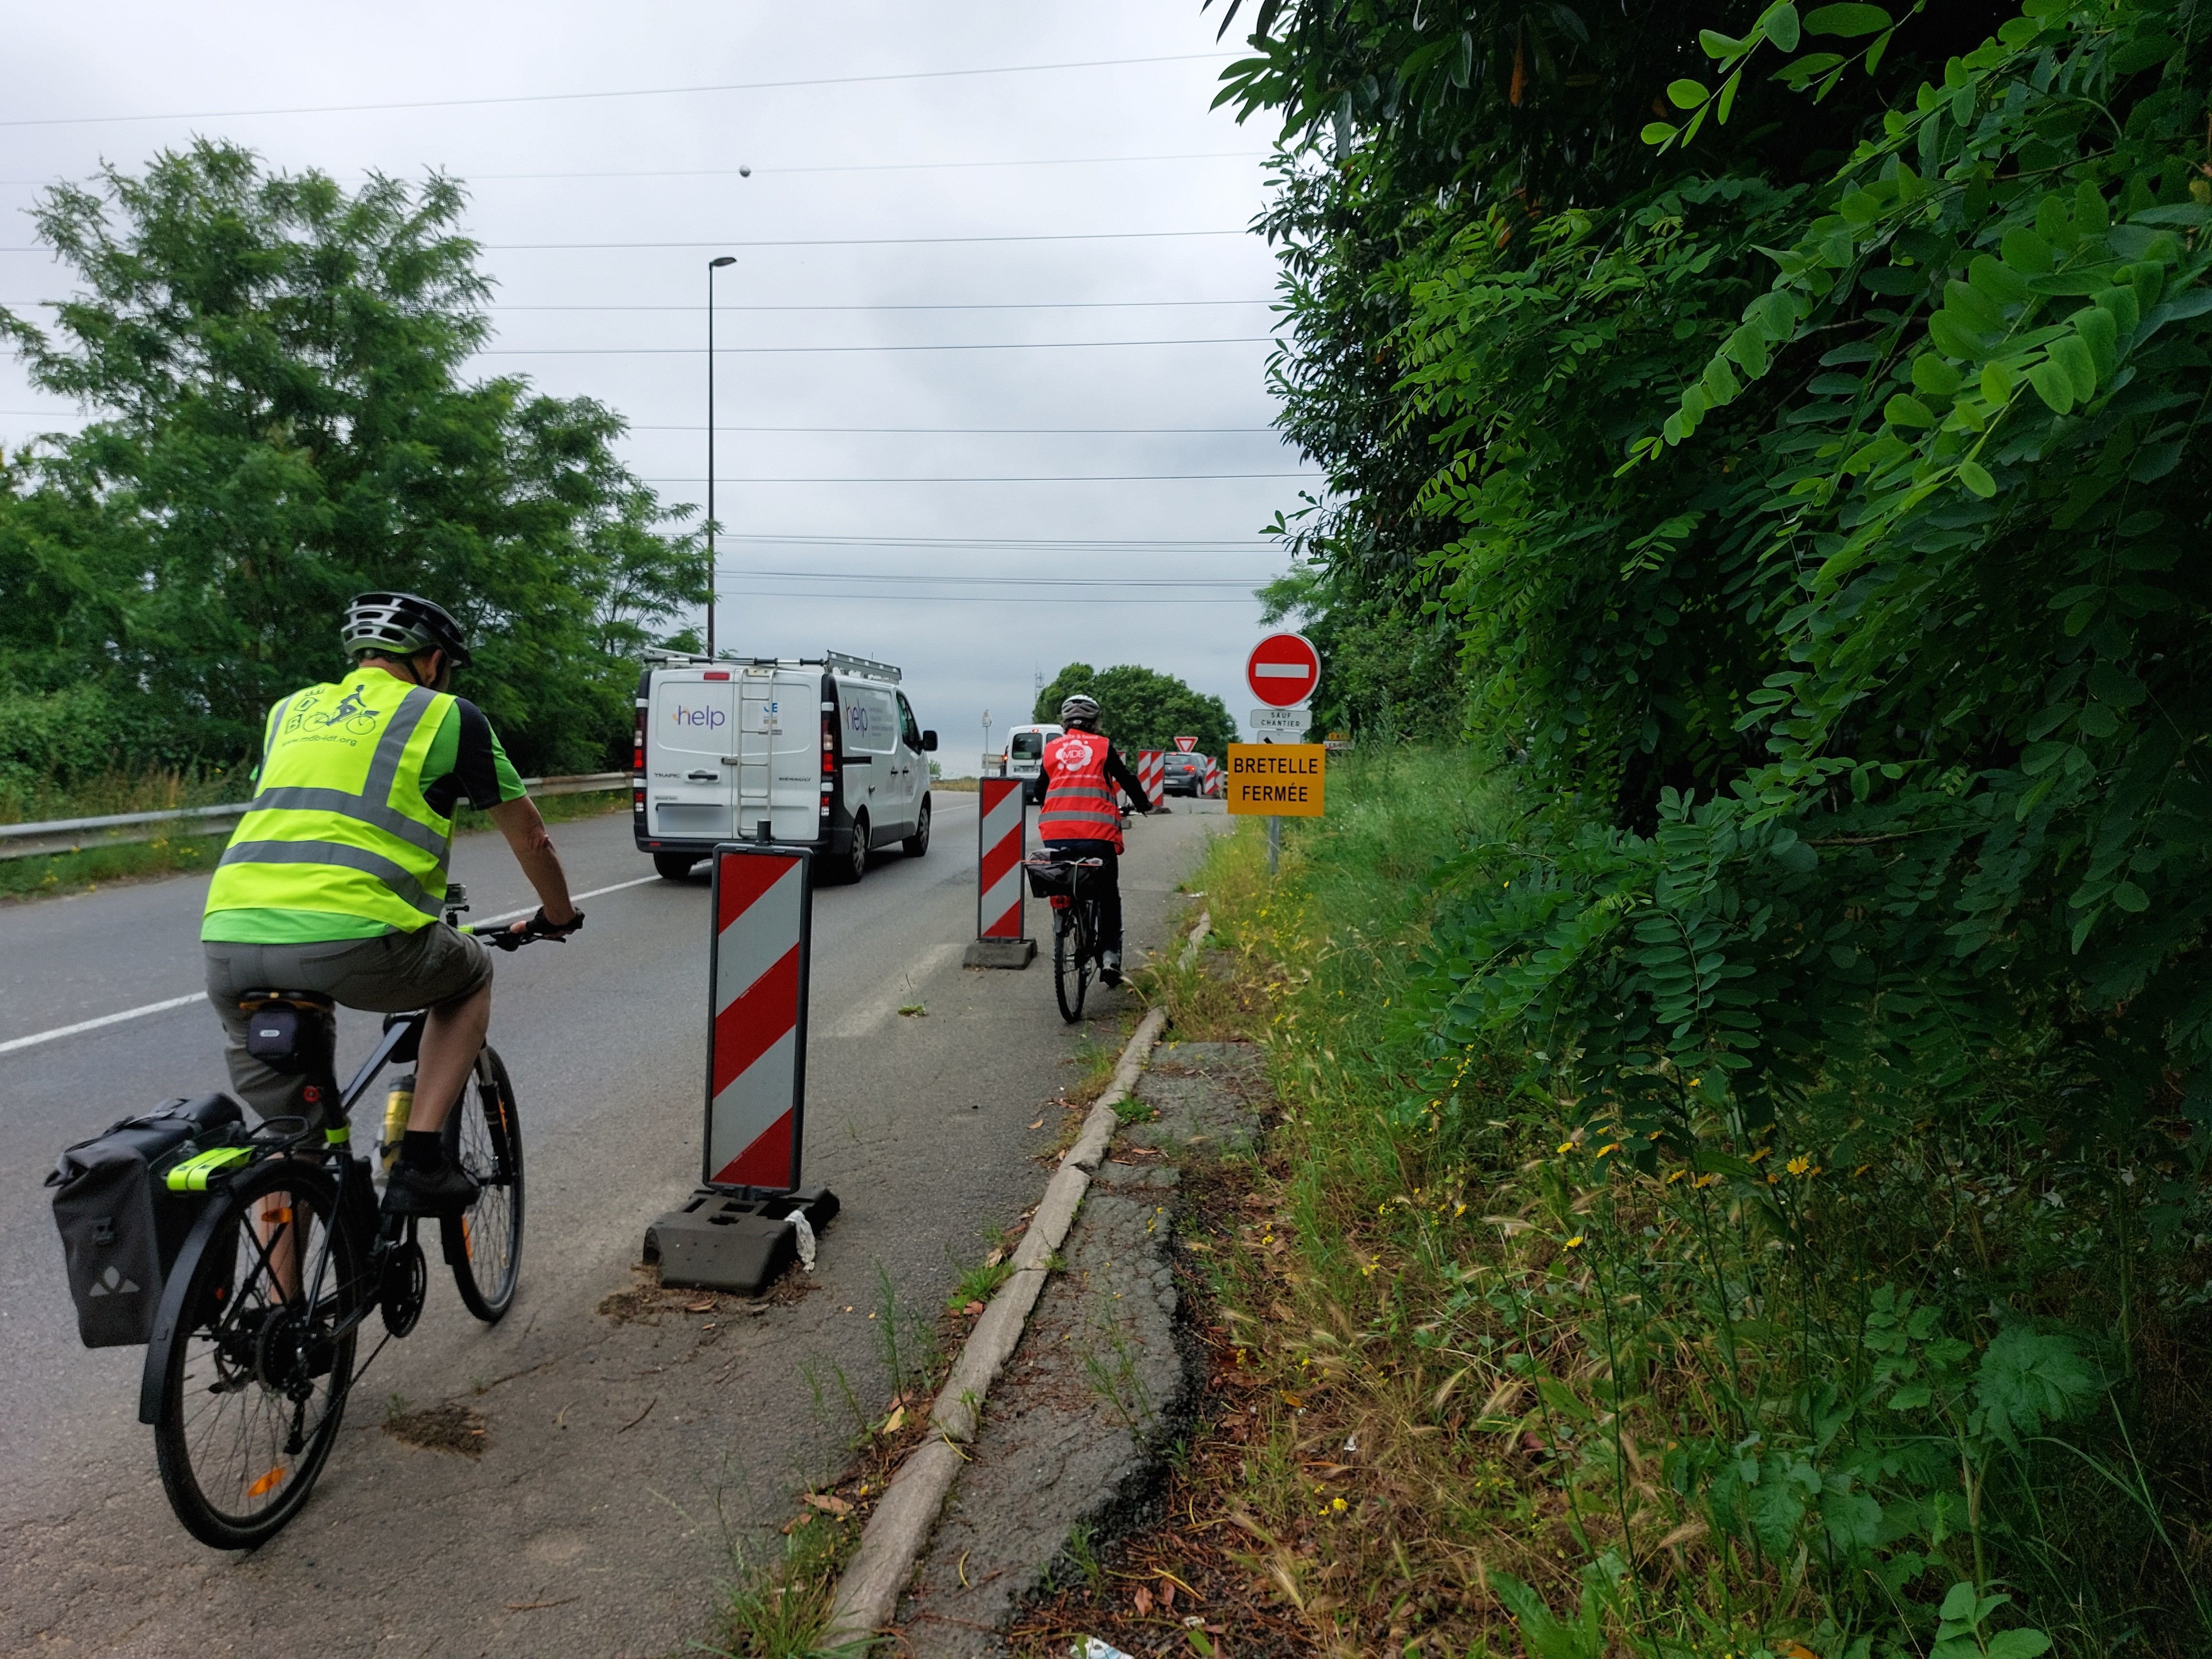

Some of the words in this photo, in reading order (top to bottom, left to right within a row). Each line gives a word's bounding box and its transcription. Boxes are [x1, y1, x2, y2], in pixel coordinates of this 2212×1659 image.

[677, 705, 726, 730] help
[845, 697, 868, 738] help
[1063, 750, 1085, 759] MDB
[1234, 757, 1318, 774] BRETELLE
[1242, 782, 1308, 802] FERMÉE
